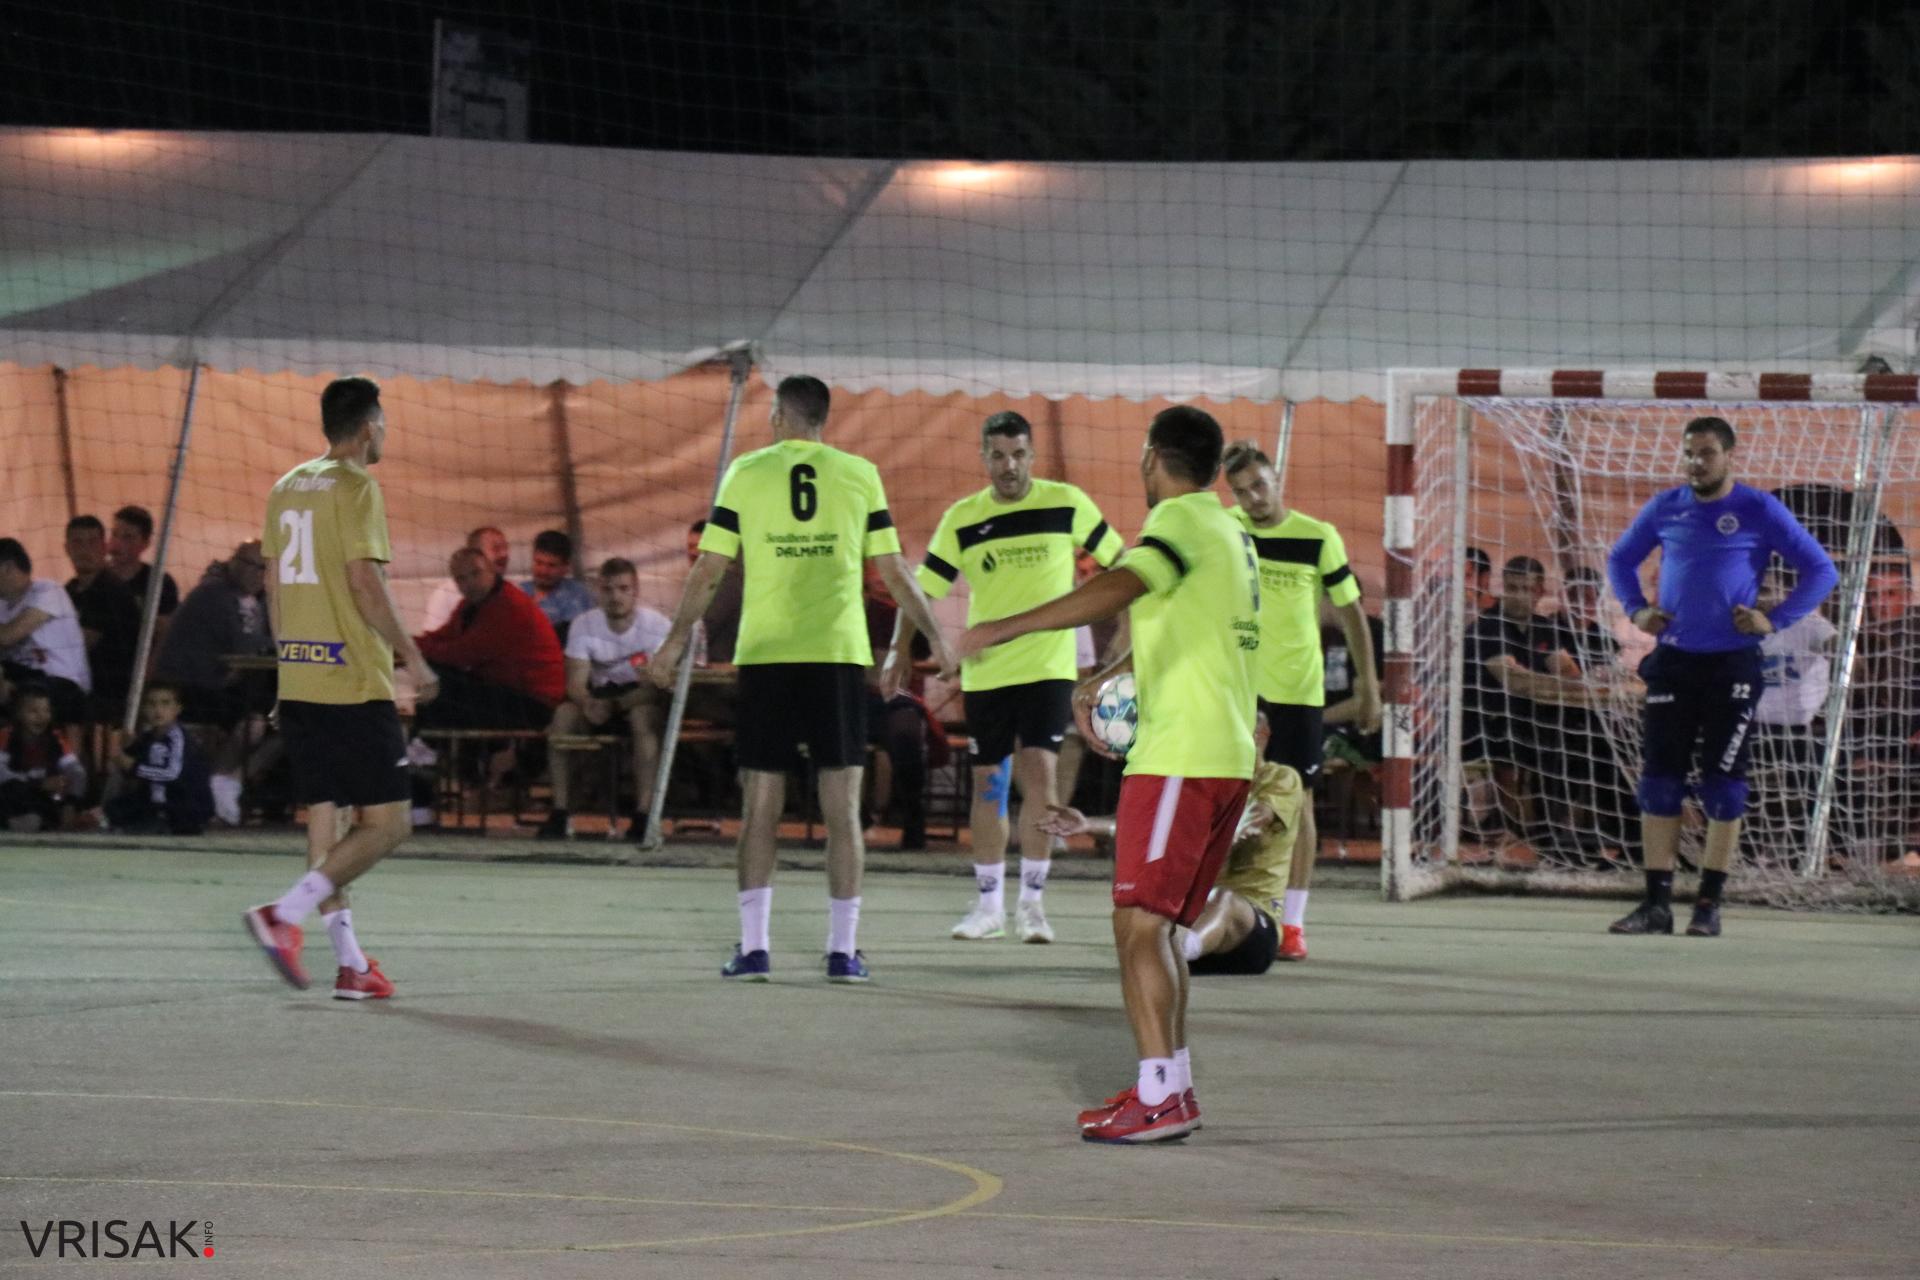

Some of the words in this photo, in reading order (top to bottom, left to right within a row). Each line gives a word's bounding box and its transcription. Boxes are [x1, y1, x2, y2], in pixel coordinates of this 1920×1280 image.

[789, 463, 817, 522] 6
[278, 508, 319, 585] 21
[1731, 683, 1751, 698] 22
